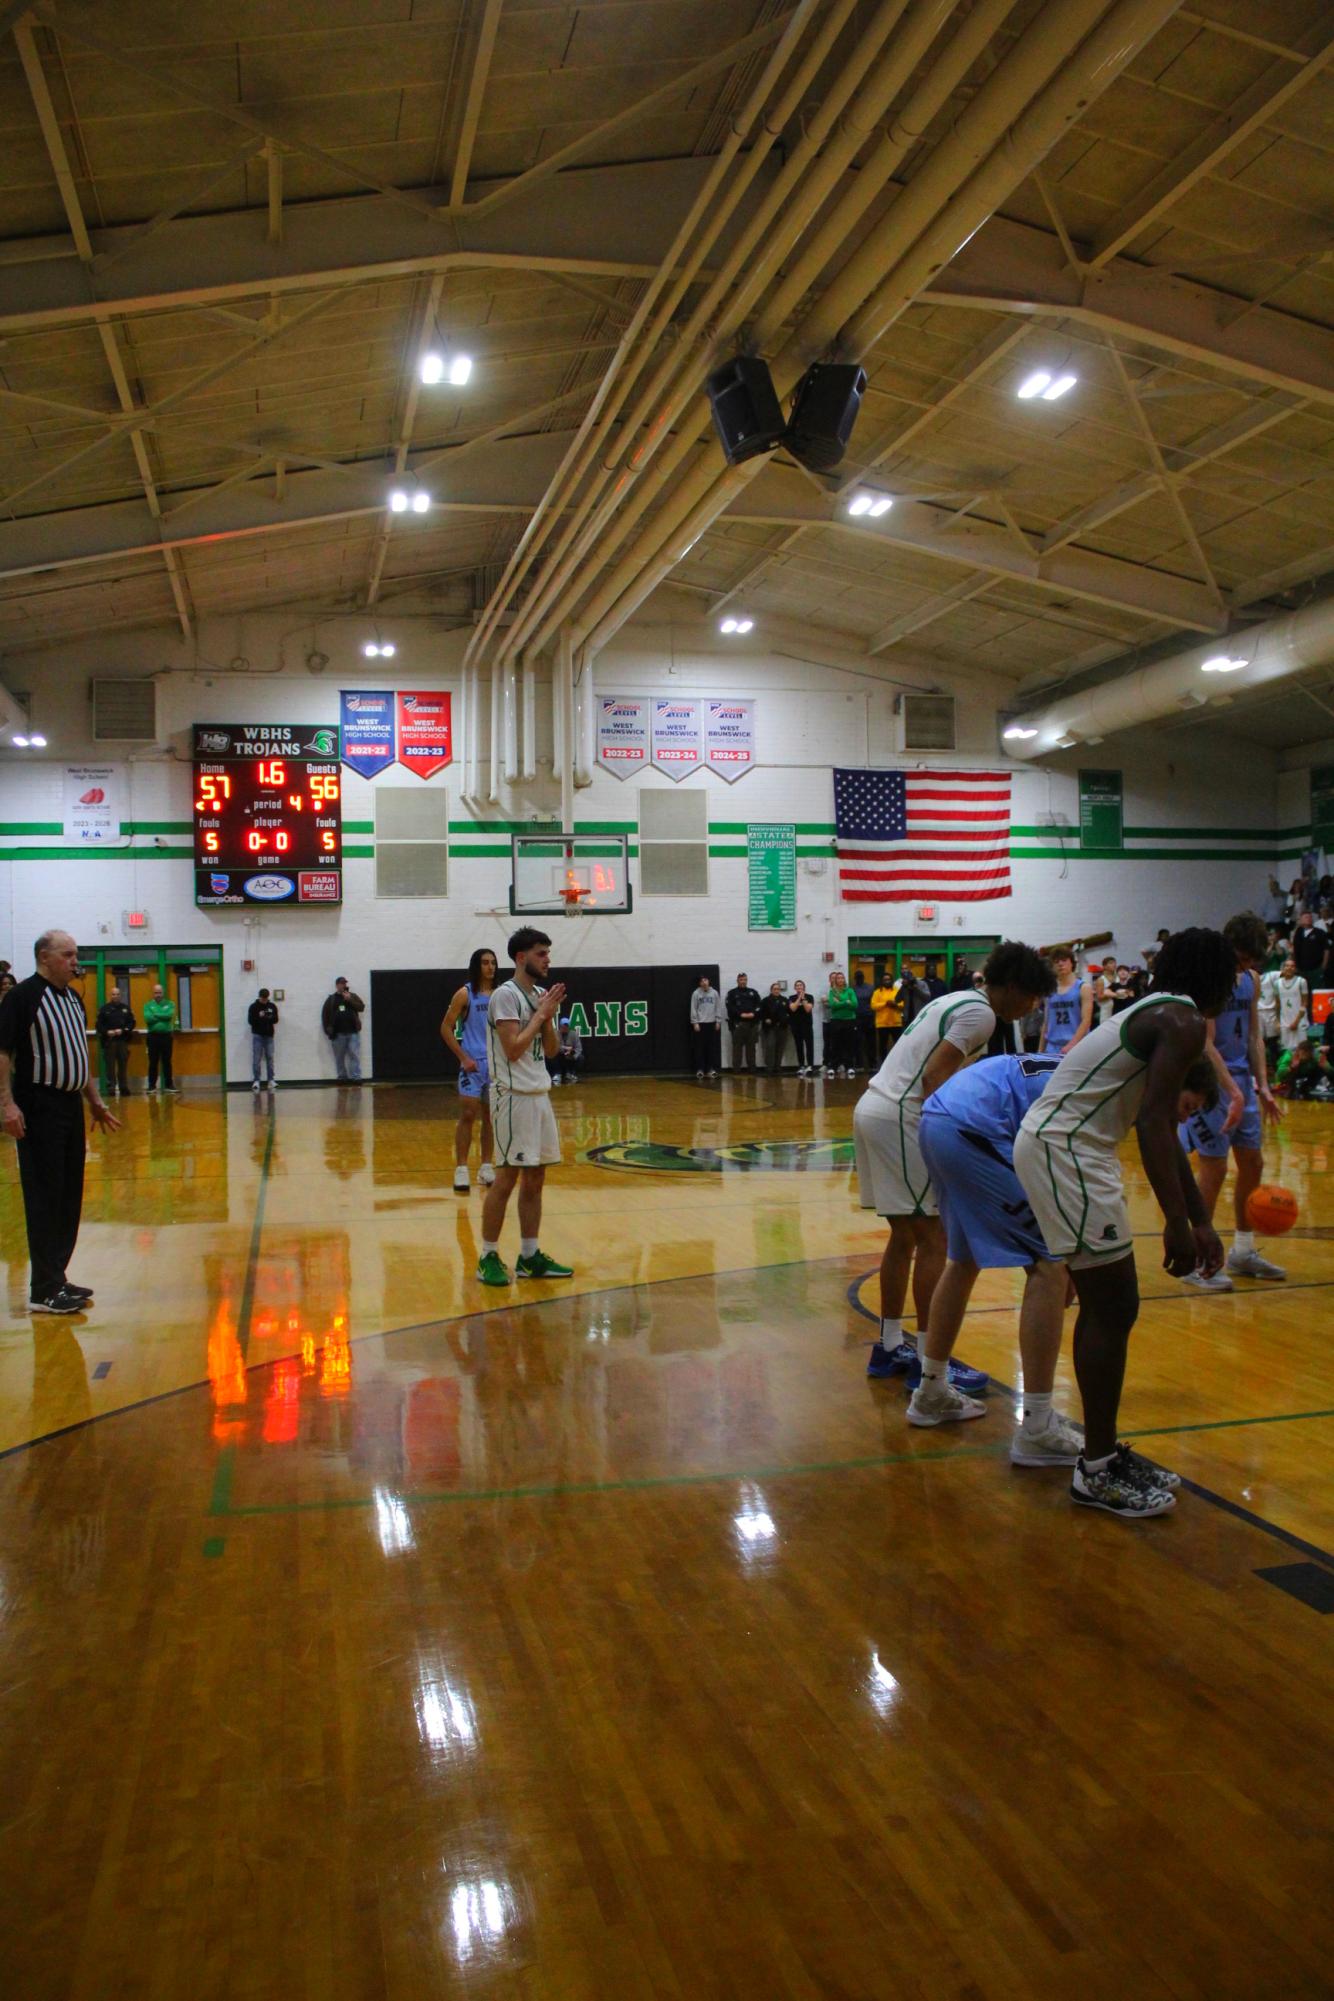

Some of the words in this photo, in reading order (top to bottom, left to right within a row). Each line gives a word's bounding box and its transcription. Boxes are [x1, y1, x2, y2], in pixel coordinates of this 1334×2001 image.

[243, 727, 291, 740] WBHS
[233, 742, 301, 756] TROJANS
[405, 747, 443, 755] 2022-23
[659, 751, 696, 759] 2023-24
[712, 752, 748, 760] 2024-25
[200, 763, 225, 773] Home
[259, 761, 285, 785] 1.6
[306, 763, 337, 774] Guests
[200, 776, 230, 800] 57
[309, 776, 339, 799] 56
[253, 800, 282, 811] period
[289, 795, 302, 811] 4
[199, 818, 220, 828] fouls
[253, 817, 283, 829] player
[316, 817, 337, 828] fouls
[205, 832, 218, 851] 5
[323, 832, 335, 850] 5
[751, 840, 794, 848] CHAMPIONS
[202, 856, 219, 864] won
[257, 856, 280, 866] game
[318, 855, 336, 864] won
[1056, 1011, 1070, 1025] 22
